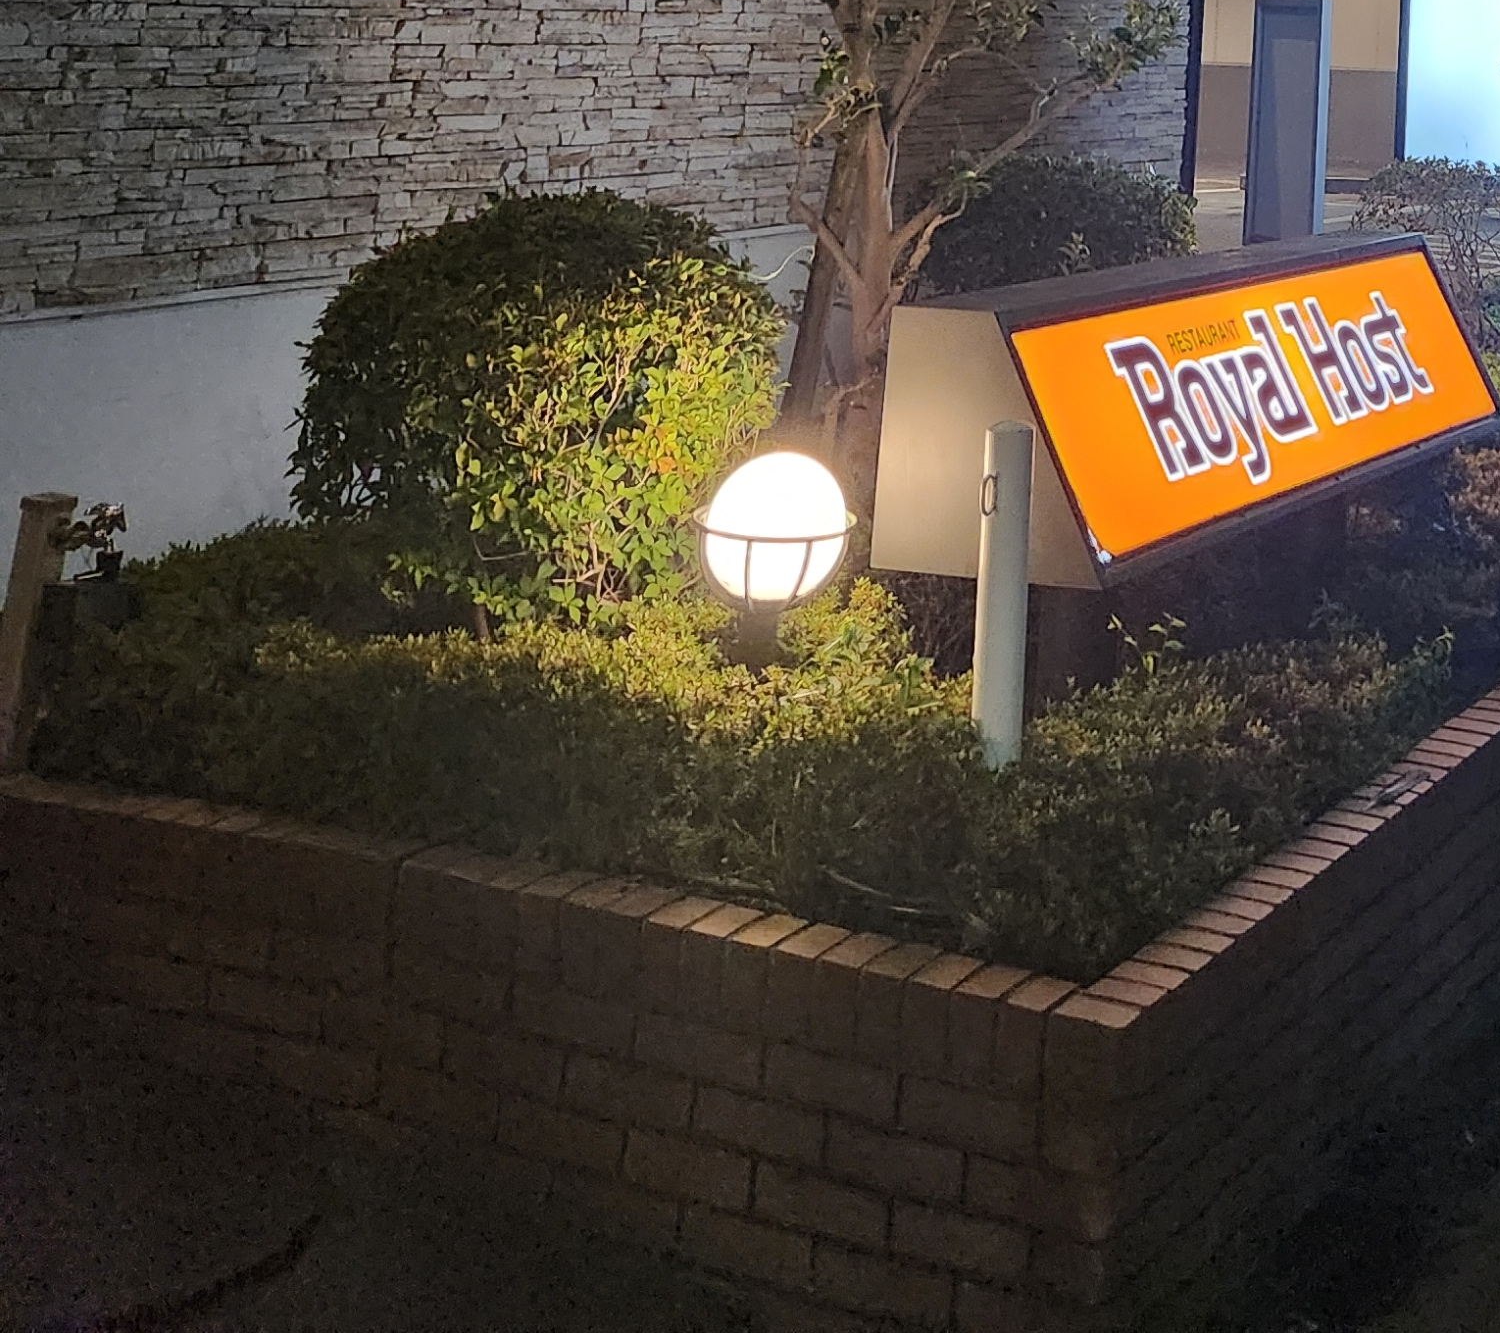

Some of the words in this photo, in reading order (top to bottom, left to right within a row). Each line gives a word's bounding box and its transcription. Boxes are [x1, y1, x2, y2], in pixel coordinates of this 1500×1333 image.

[1105, 309, 1318, 485] Royal
[1274, 291, 1434, 426] Host
[1166, 319, 1241, 355] RESTAURANT
